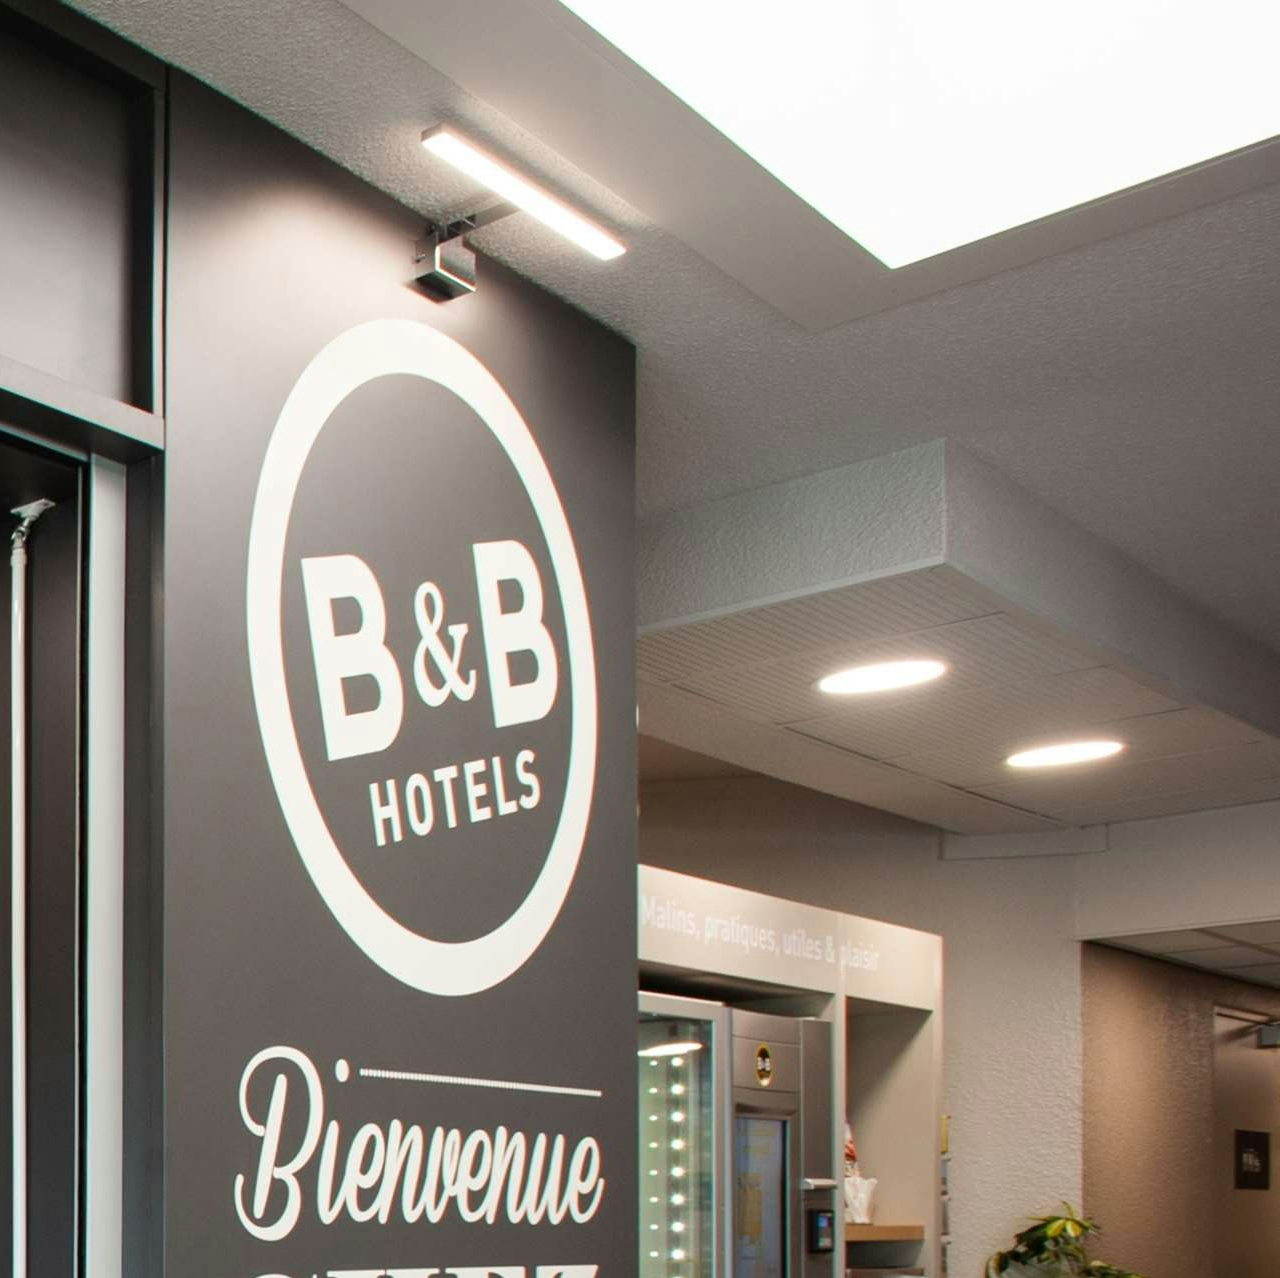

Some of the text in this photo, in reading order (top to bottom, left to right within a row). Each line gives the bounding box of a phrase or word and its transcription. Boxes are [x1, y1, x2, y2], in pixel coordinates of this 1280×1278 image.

[301, 539, 558, 761] B&B
[369, 749, 541, 847] HOTELS
[704, 914, 778, 953] pratiques,
[782, 927, 822, 961] utiles
[235, 1045, 605, 1241] Bienvenue
